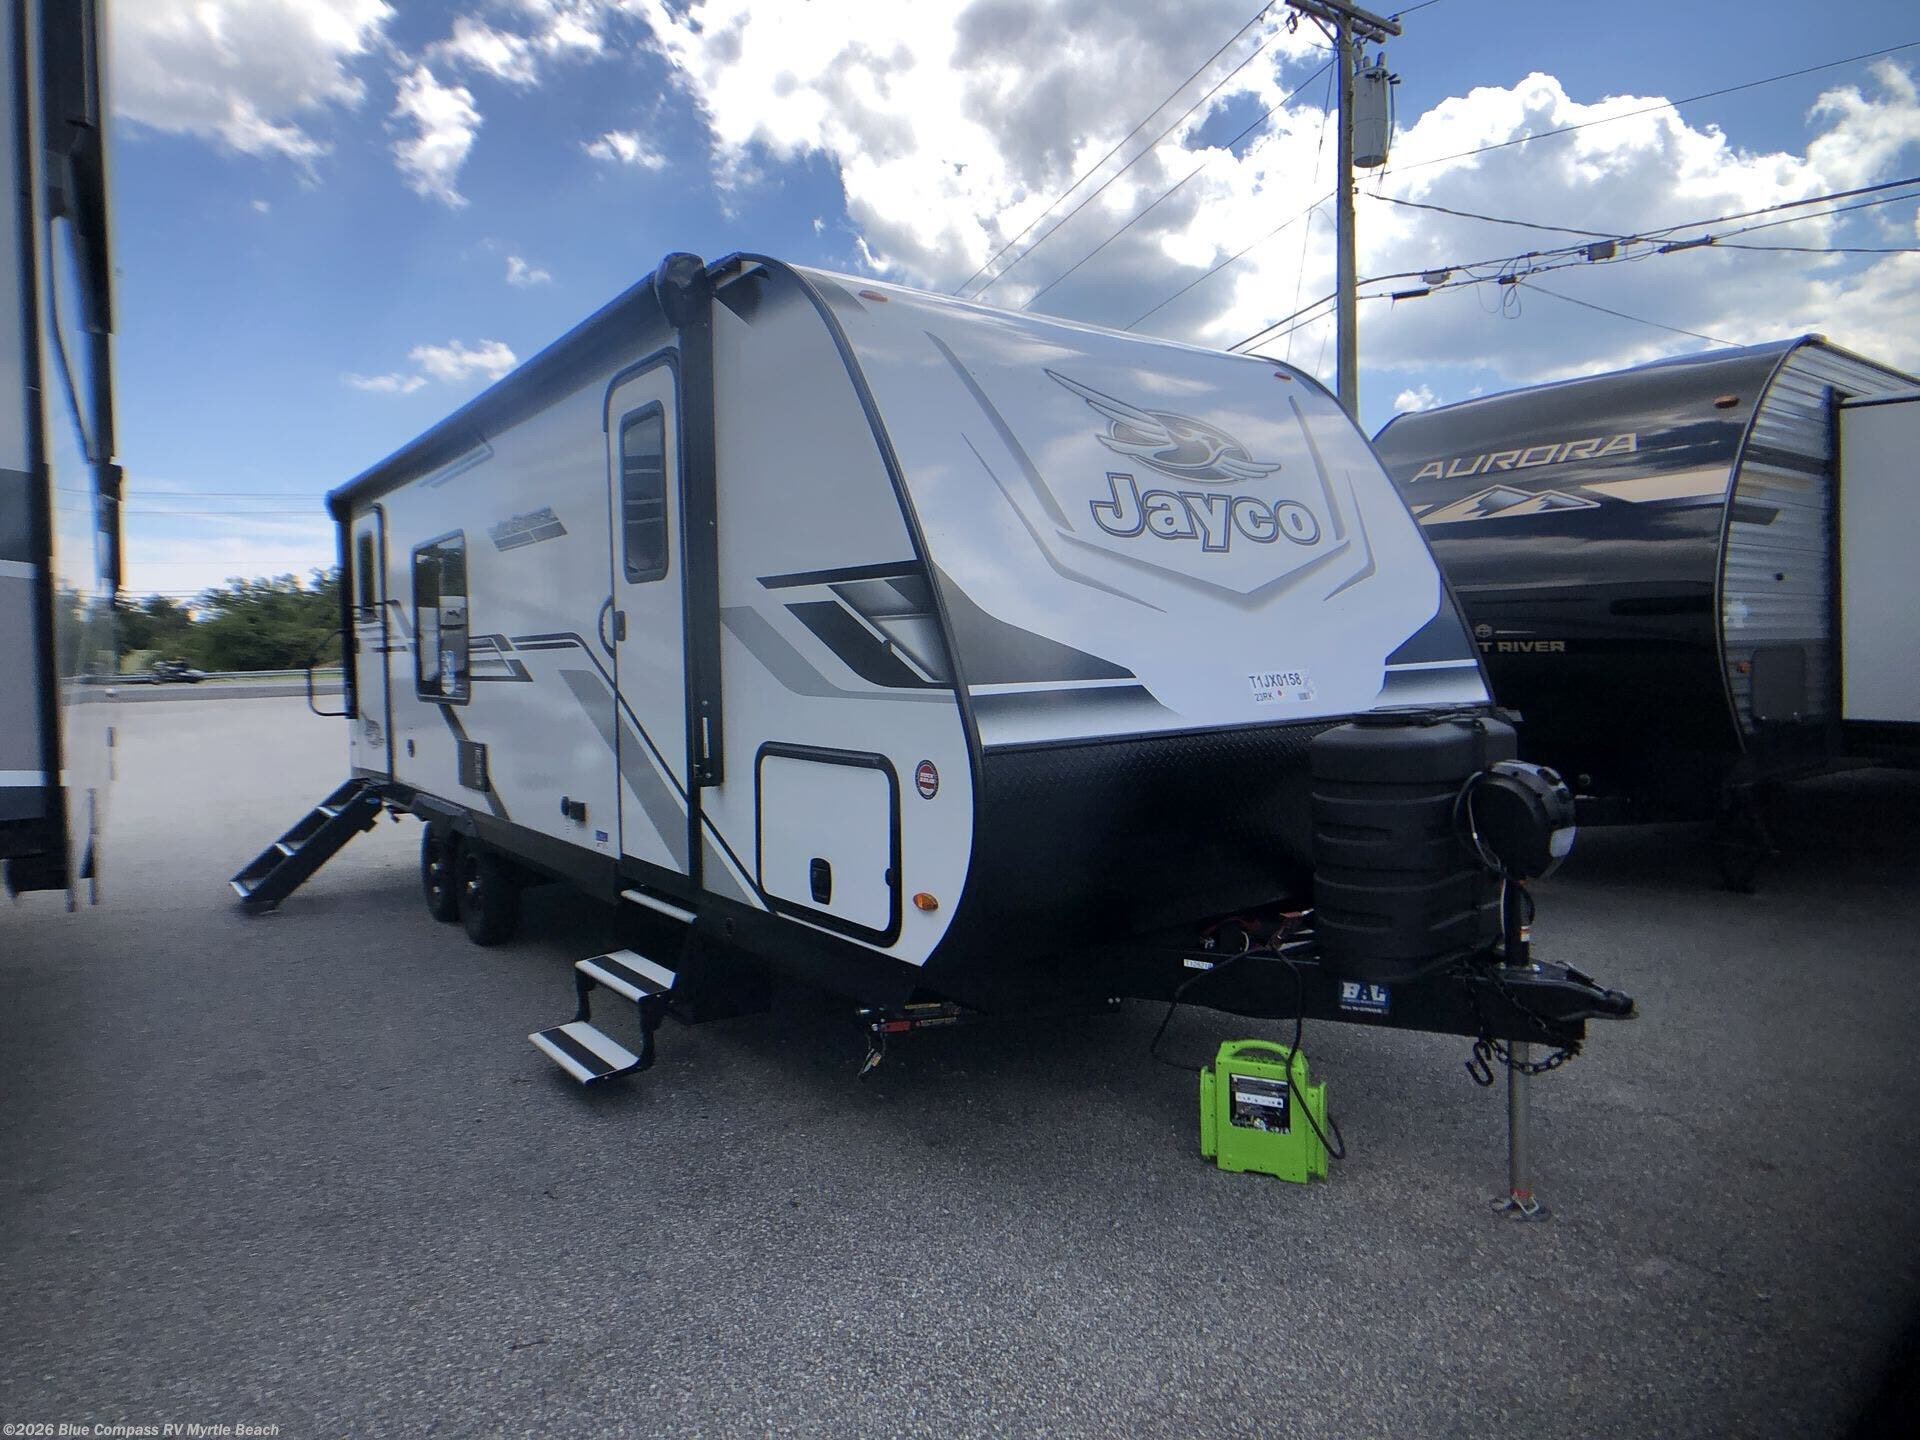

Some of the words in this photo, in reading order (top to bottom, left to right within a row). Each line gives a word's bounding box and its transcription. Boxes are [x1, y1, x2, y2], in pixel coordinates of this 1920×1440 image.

[1410, 433, 1638, 483] AURORA
[1089, 472, 1321, 553] Jayco
[1496, 641, 1566, 653] RIVER
[1249, 673, 1302, 688] T1JX0158
